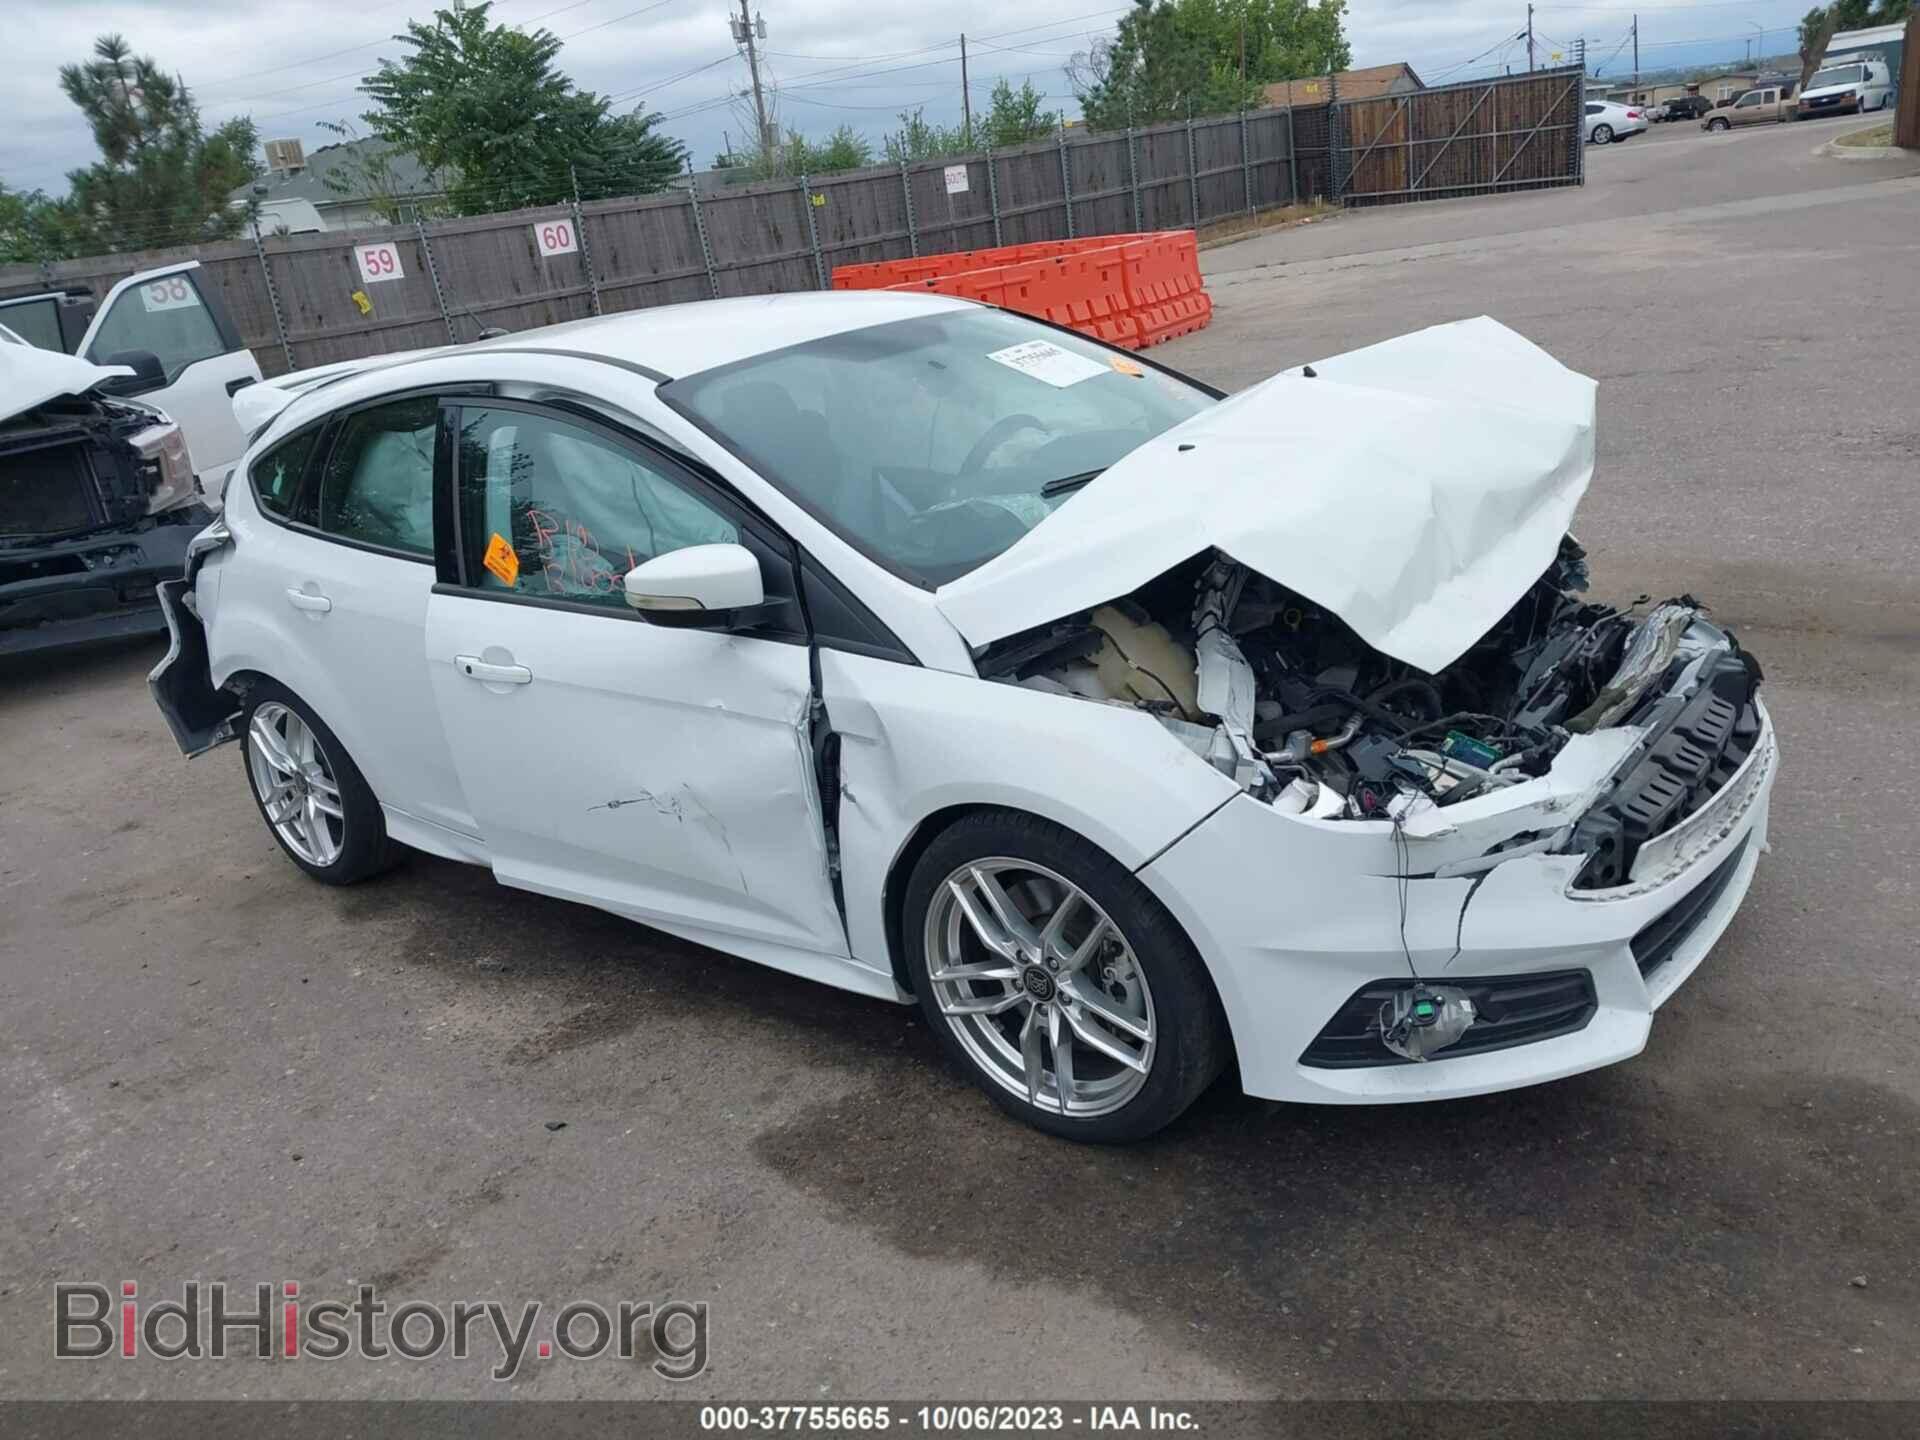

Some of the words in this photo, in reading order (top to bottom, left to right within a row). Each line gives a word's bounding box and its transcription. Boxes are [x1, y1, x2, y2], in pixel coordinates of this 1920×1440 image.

[543, 224, 570, 250] 60
[364, 248, 394, 276] 59
[150, 277, 187, 304] 58
